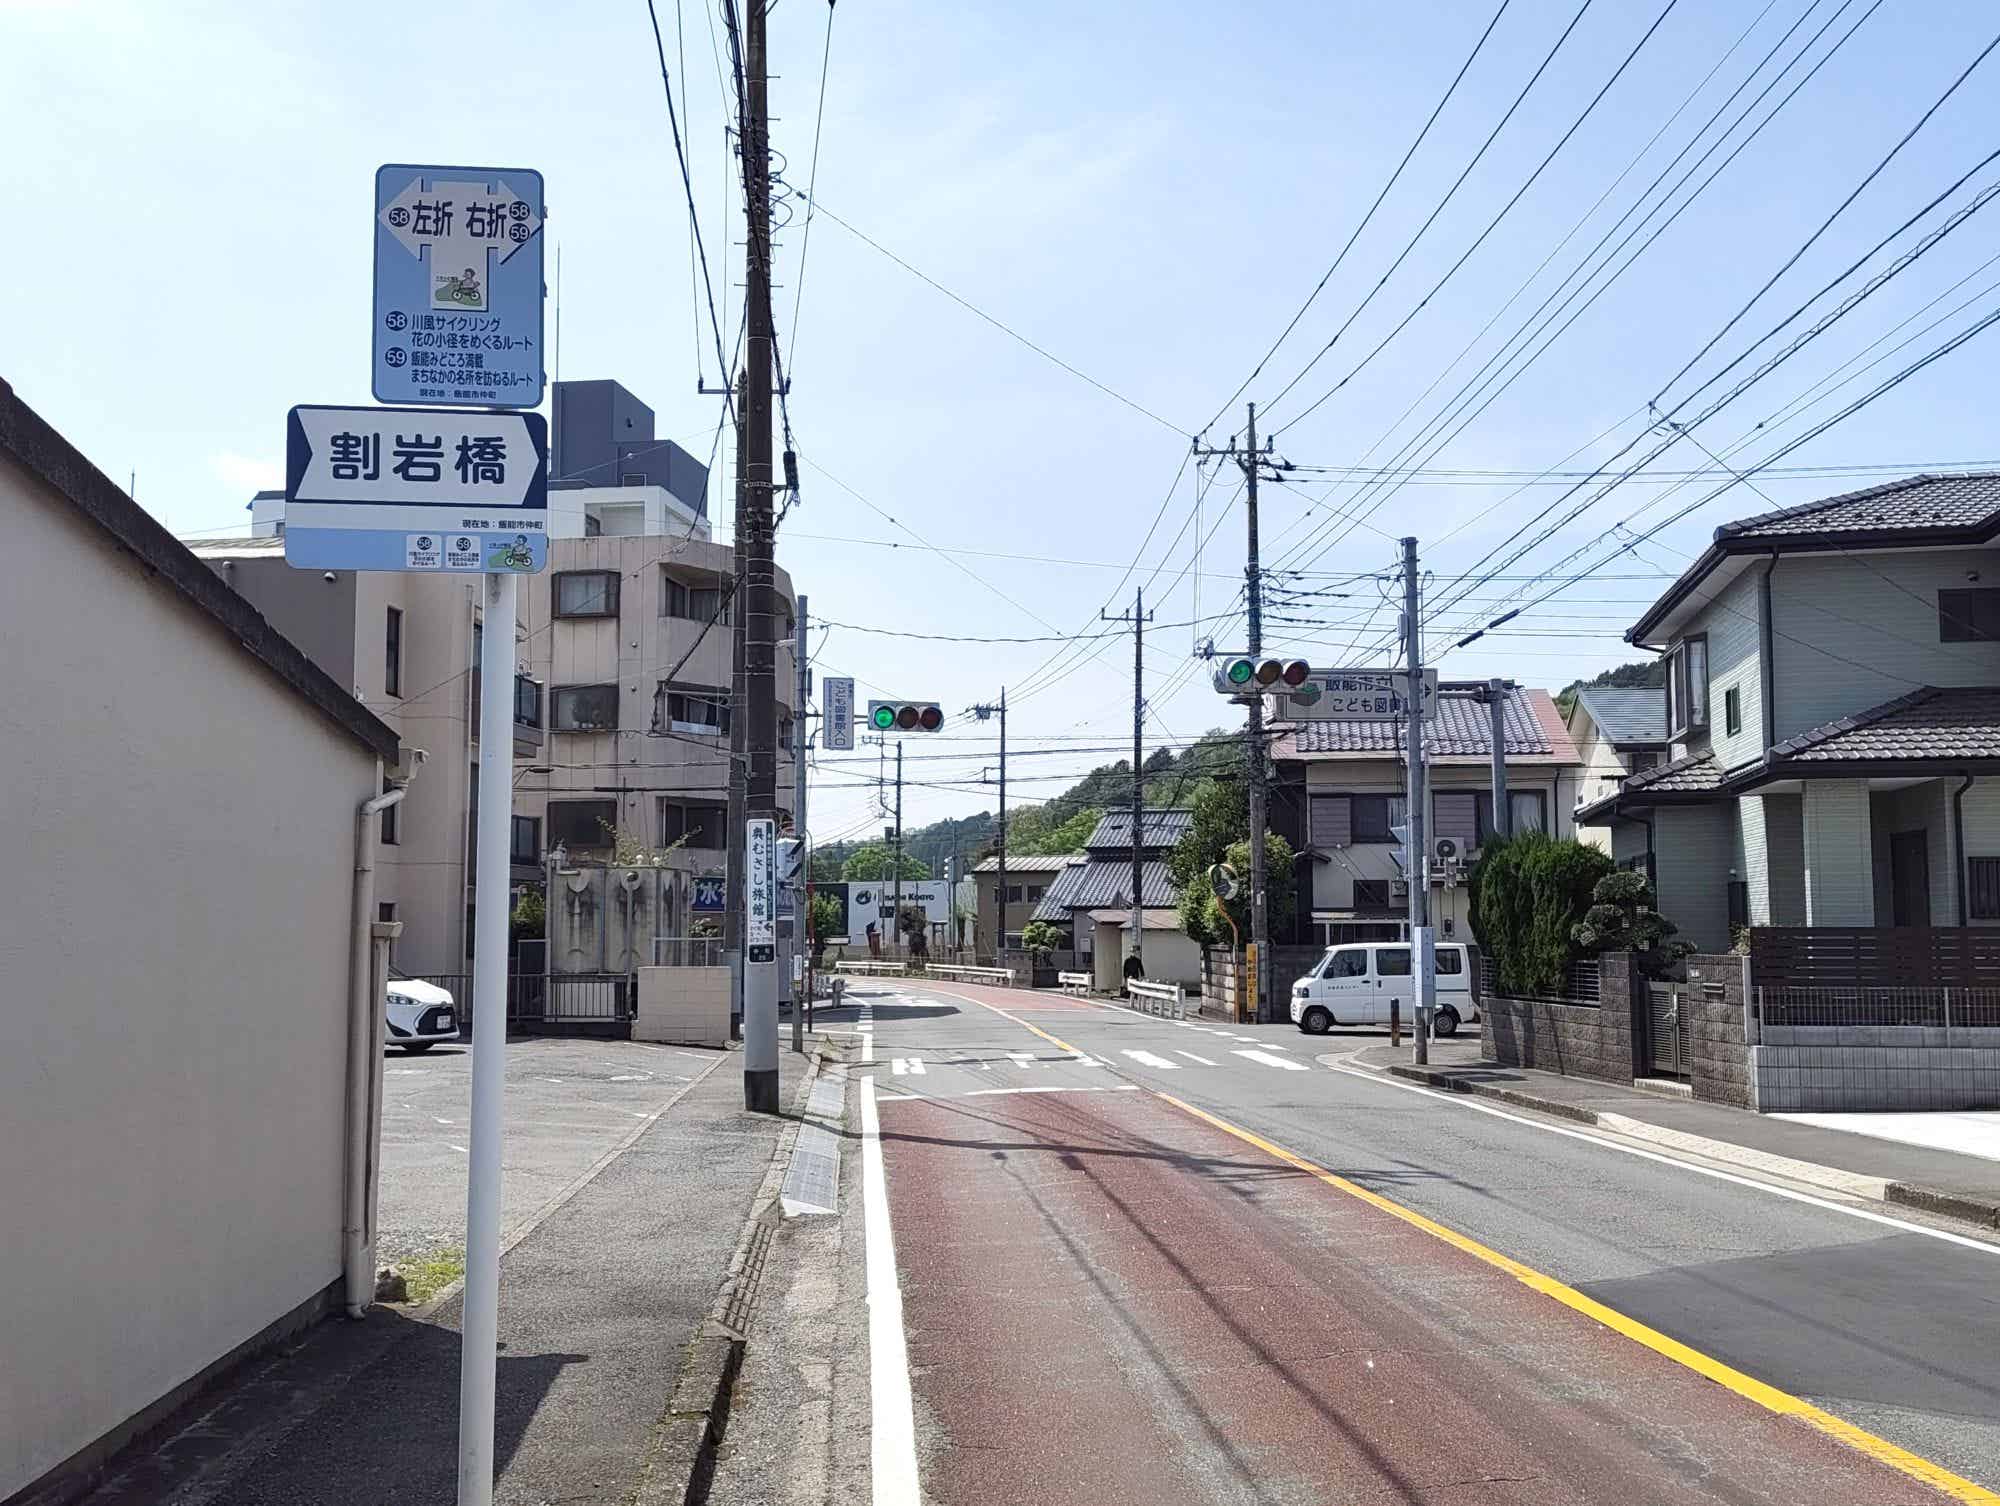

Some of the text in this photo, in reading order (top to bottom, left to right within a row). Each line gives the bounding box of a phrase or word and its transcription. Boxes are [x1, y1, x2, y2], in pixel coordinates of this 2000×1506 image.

[390, 200, 530, 239] 58 左折 右折 58
[510, 225, 530, 241] 59
[387, 312, 501, 333] 58 川風サイクリング
[411, 332, 533, 351] 花の小径をめぐるルート
[386, 349, 484, 369] 59 飯能みどころ満載
[411, 369, 533, 387] まちなかの名所を訪ねるルート
[329, 431, 506, 485] 割岩橋
[417, 537, 433, 549] 58
[456, 538, 472, 550] 59
